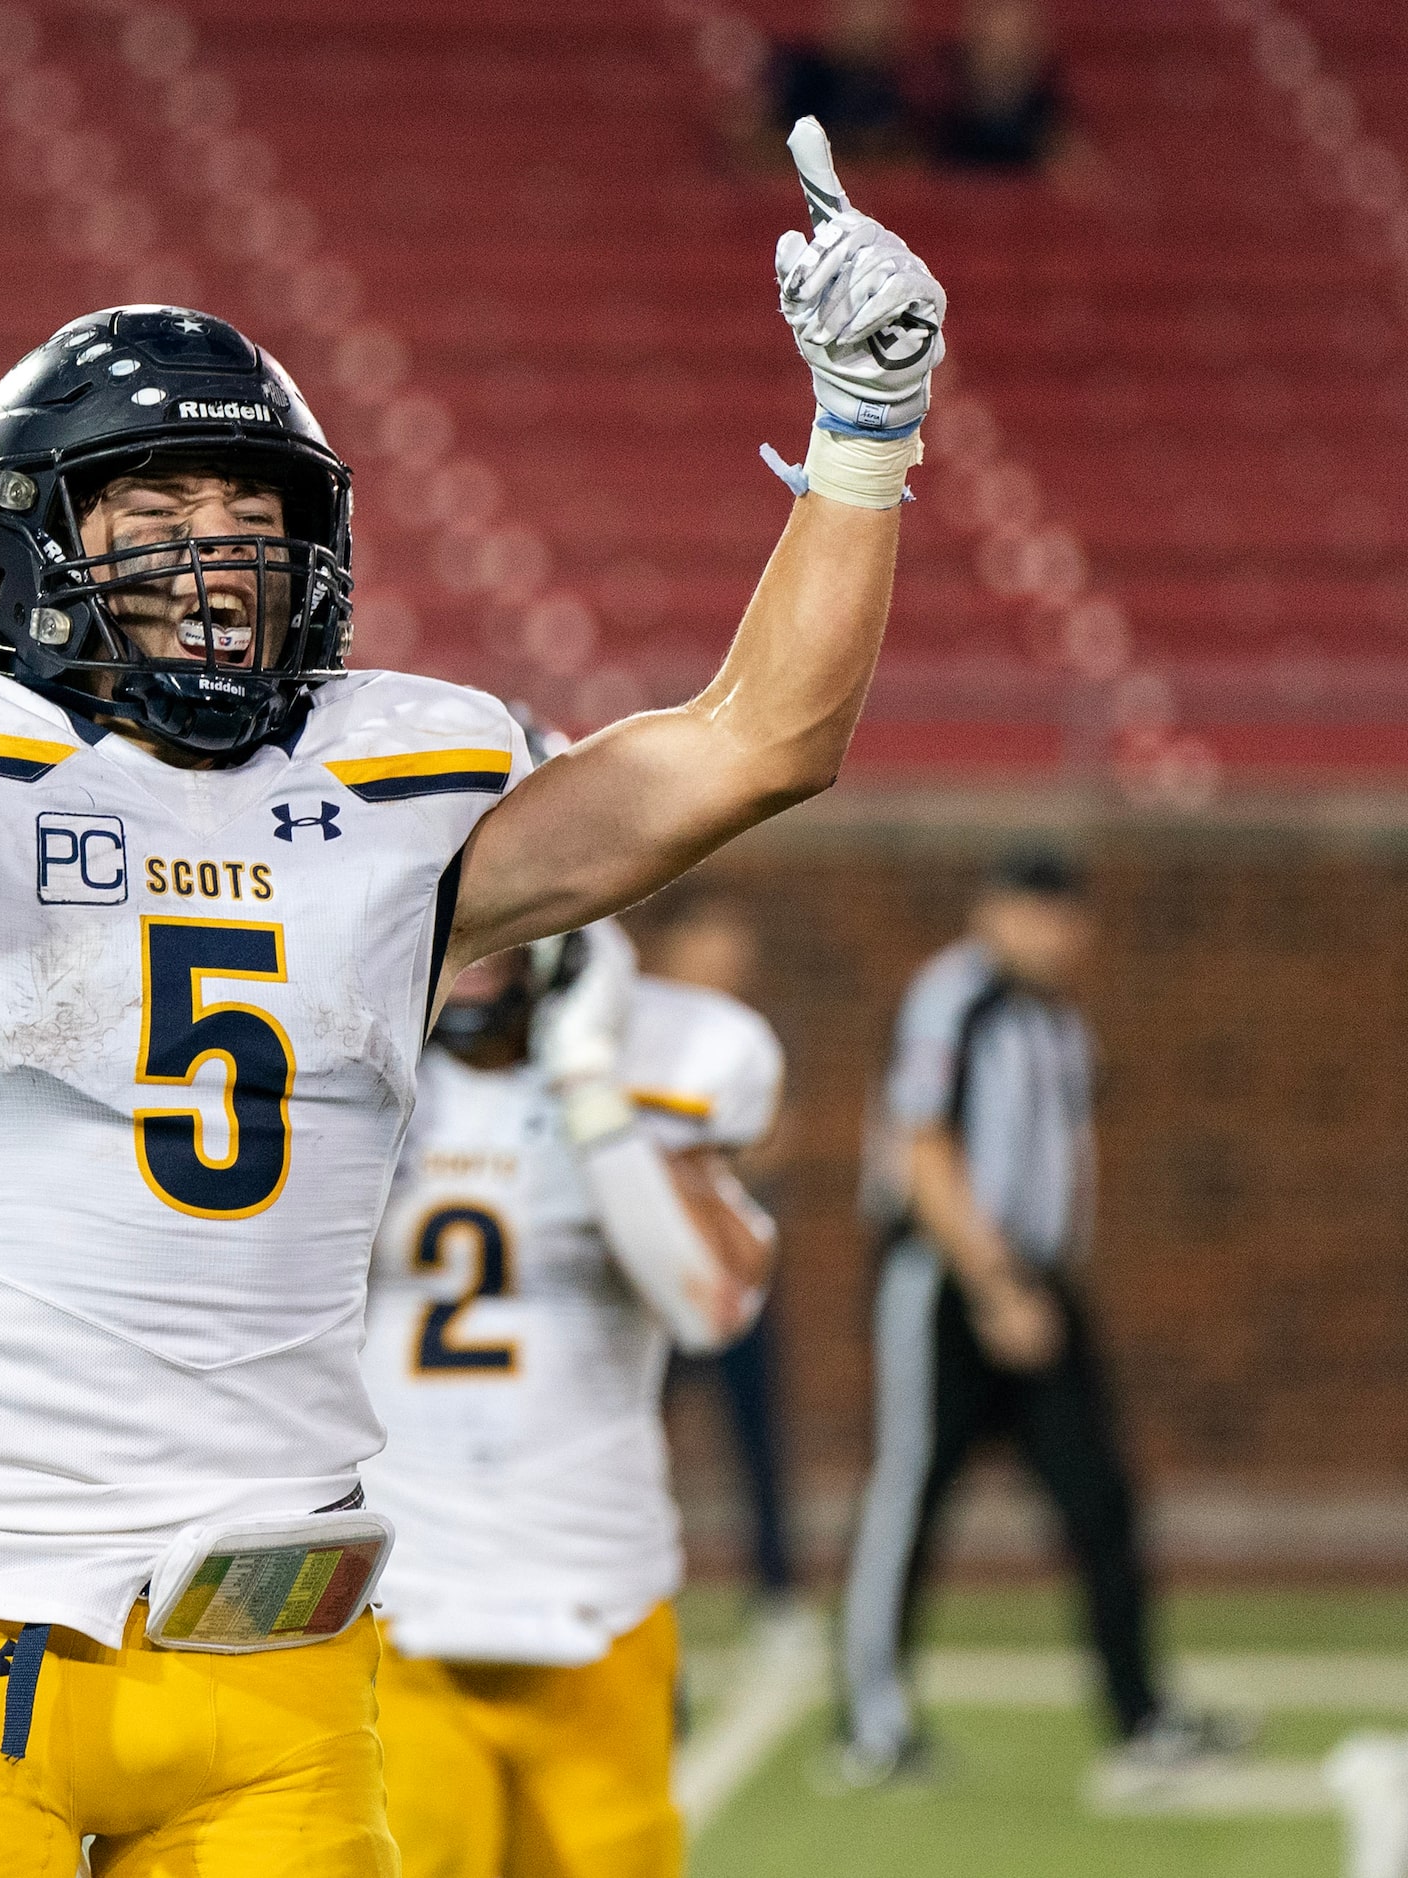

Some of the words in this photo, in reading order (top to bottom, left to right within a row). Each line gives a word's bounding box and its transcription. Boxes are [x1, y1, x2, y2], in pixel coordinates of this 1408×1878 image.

[178, 401, 271, 422] Riddell
[199, 679, 246, 698] Riddell
[40, 827, 123, 889] PC
[144, 855, 275, 902] SCOTS
[133, 914, 297, 1220] 5
[410, 1199, 520, 1377] 2
